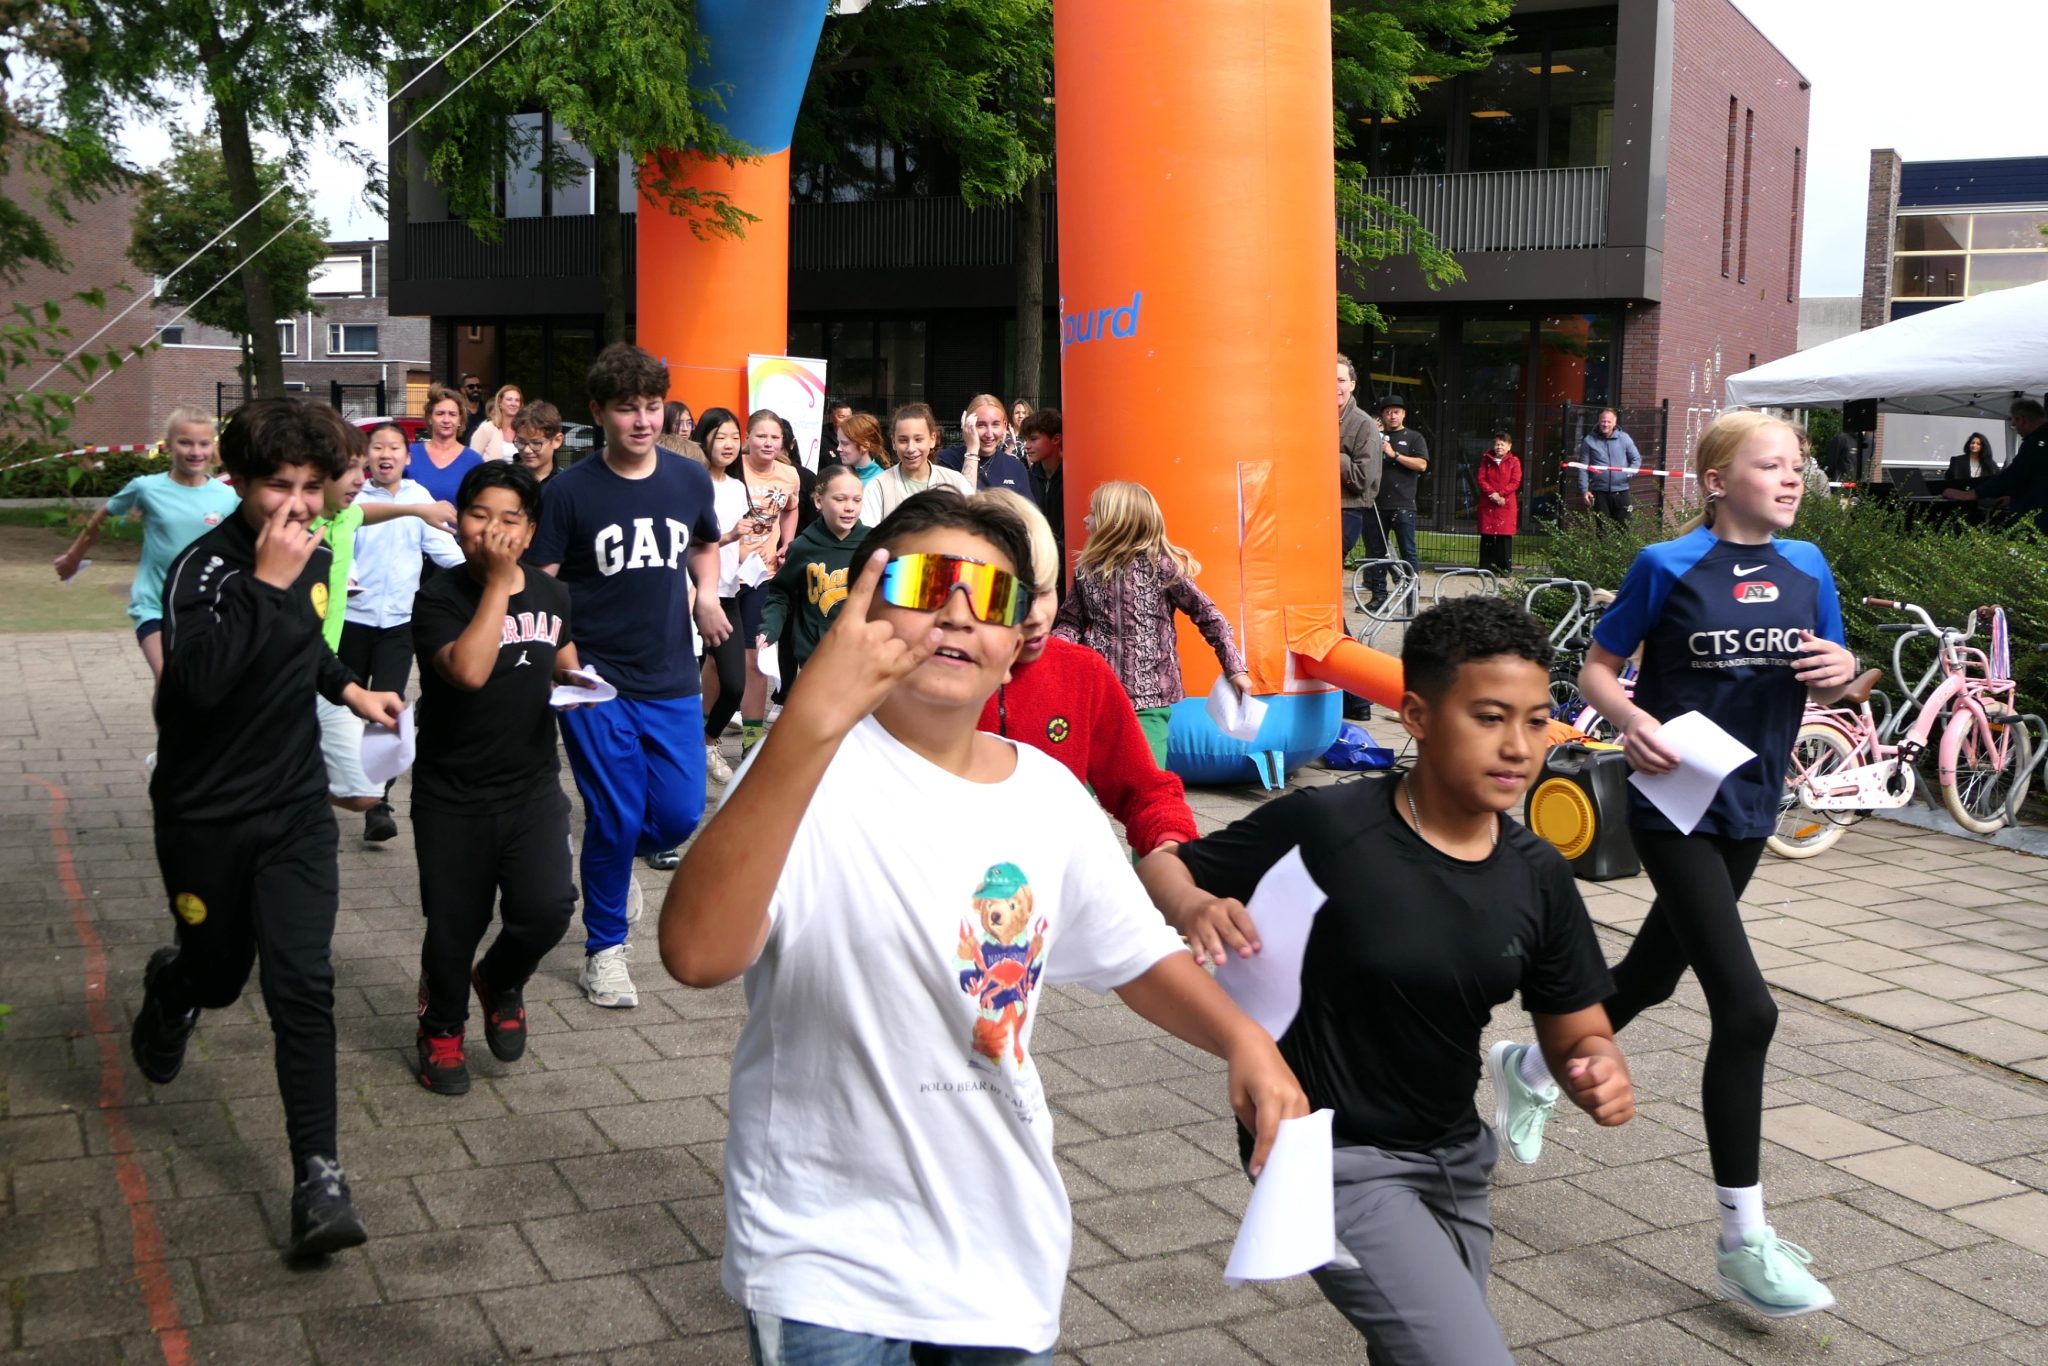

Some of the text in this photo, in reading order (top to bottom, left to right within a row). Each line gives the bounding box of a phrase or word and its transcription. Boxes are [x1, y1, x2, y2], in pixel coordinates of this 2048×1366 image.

[595, 517, 690, 576] GAP
[806, 562, 849, 604] Cha
[1743, 584, 1772, 600] AZ
[499, 611, 562, 648] RDAN
[1688, 627, 1814, 656] CTS GRO
[920, 1082, 953, 1093] POLO
[957, 1081, 987, 1093] BEAR
